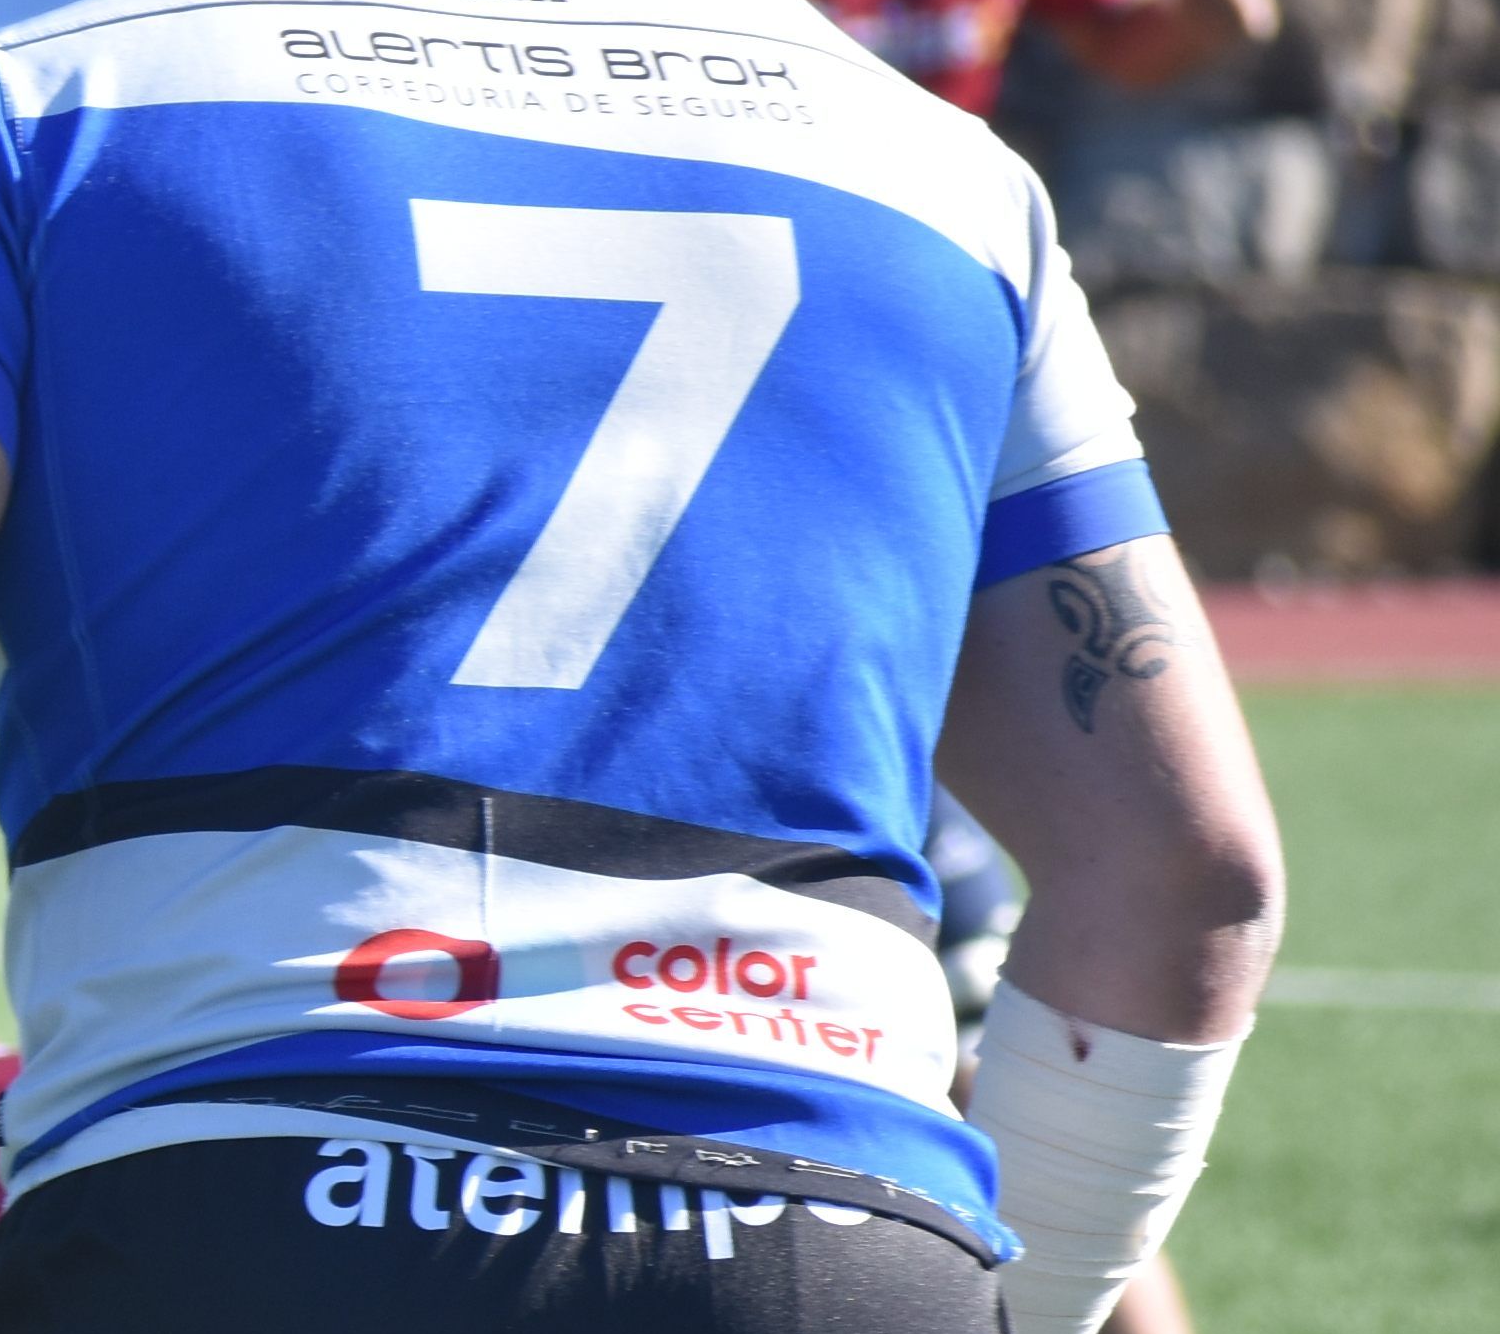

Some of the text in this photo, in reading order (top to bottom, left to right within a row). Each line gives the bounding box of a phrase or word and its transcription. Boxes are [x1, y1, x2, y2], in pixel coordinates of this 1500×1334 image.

[295, 73, 815, 126] CORREDURIA DE SEGUROS
[410, 198, 800, 690] 7
[612, 937, 818, 1000] color
[623, 1003, 884, 1064] center
